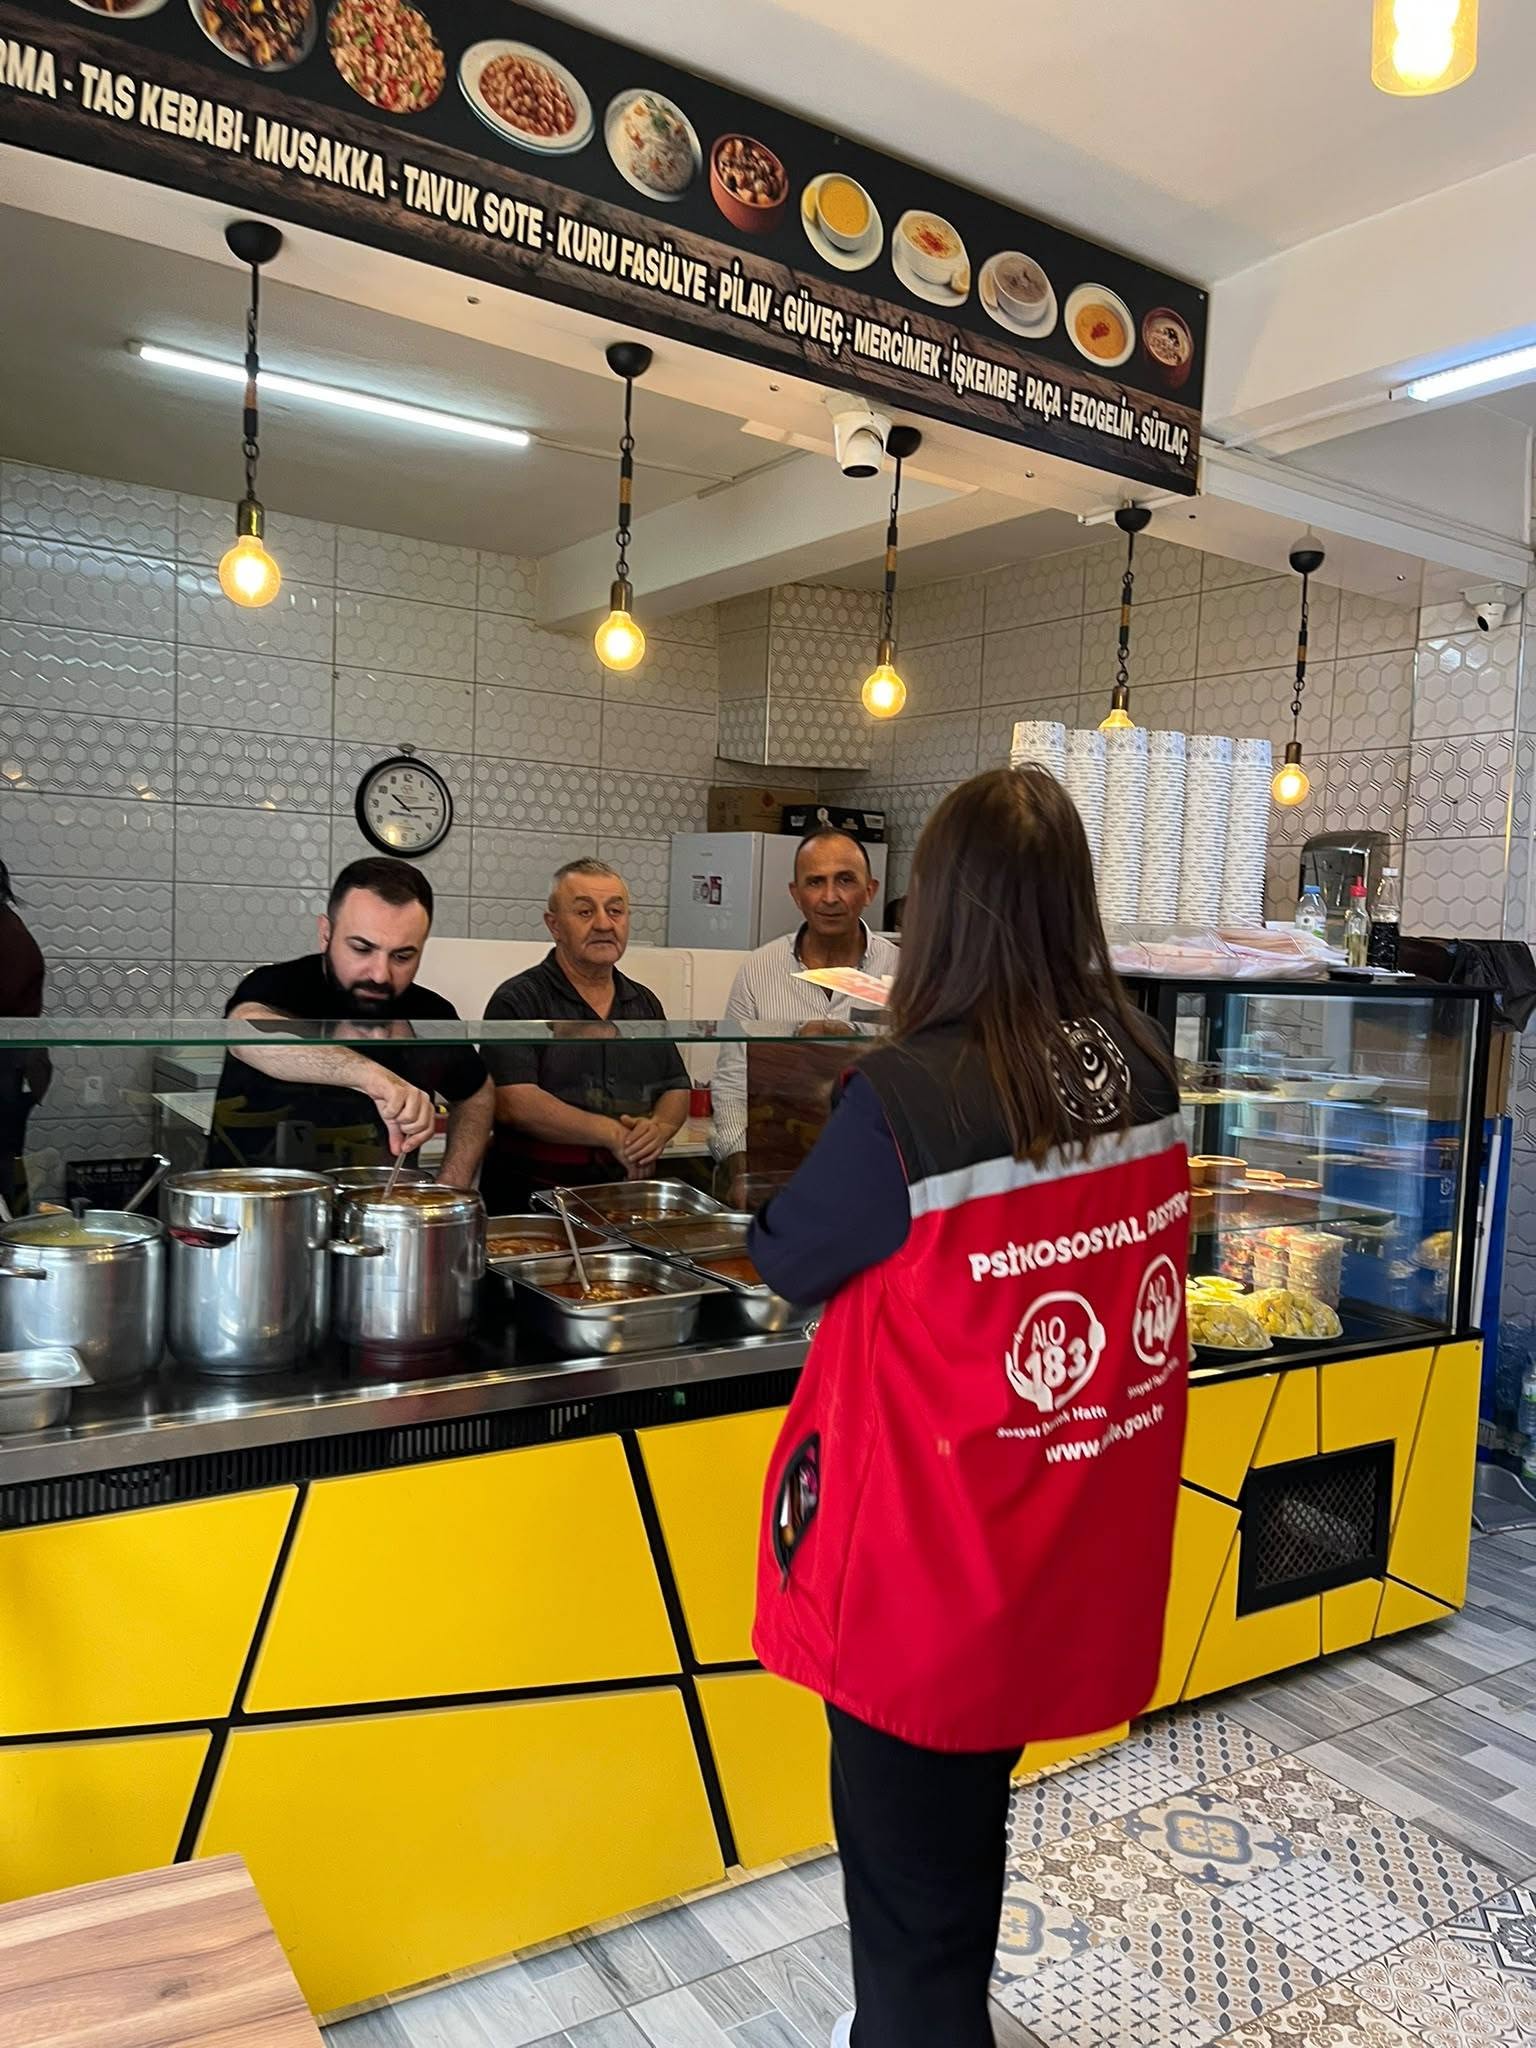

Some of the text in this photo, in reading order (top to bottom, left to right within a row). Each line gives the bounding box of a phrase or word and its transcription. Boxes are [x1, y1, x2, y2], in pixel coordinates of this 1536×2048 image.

[79, 62, 136, 120] TAS
[254, 116, 385, 198] MUSAKKA
[403, 163, 480, 228] TAVUK
[482, 192, 544, 249] SOTE
[557, 216, 618, 272] KURU
[619, 241, 708, 303] FASÜLYE
[718, 261, 773, 323] PİLAV
[783, 289, 844, 355] GÜVEÇ
[854, 320, 942, 379] MERCİMEK
[950, 337, 1018, 403] İŞKEMBE
[1025, 376, 1061, 422] PAÇA
[1069, 391, 1134, 441] EZOGELİN
[1140, 410, 1189, 465] SÜTLAÇ
[968, 1216, 1147, 1282] PSİKOSOSYAL
[1031, 1316, 1066, 1351] ALO
[1024, 1337, 1087, 1392] 183
